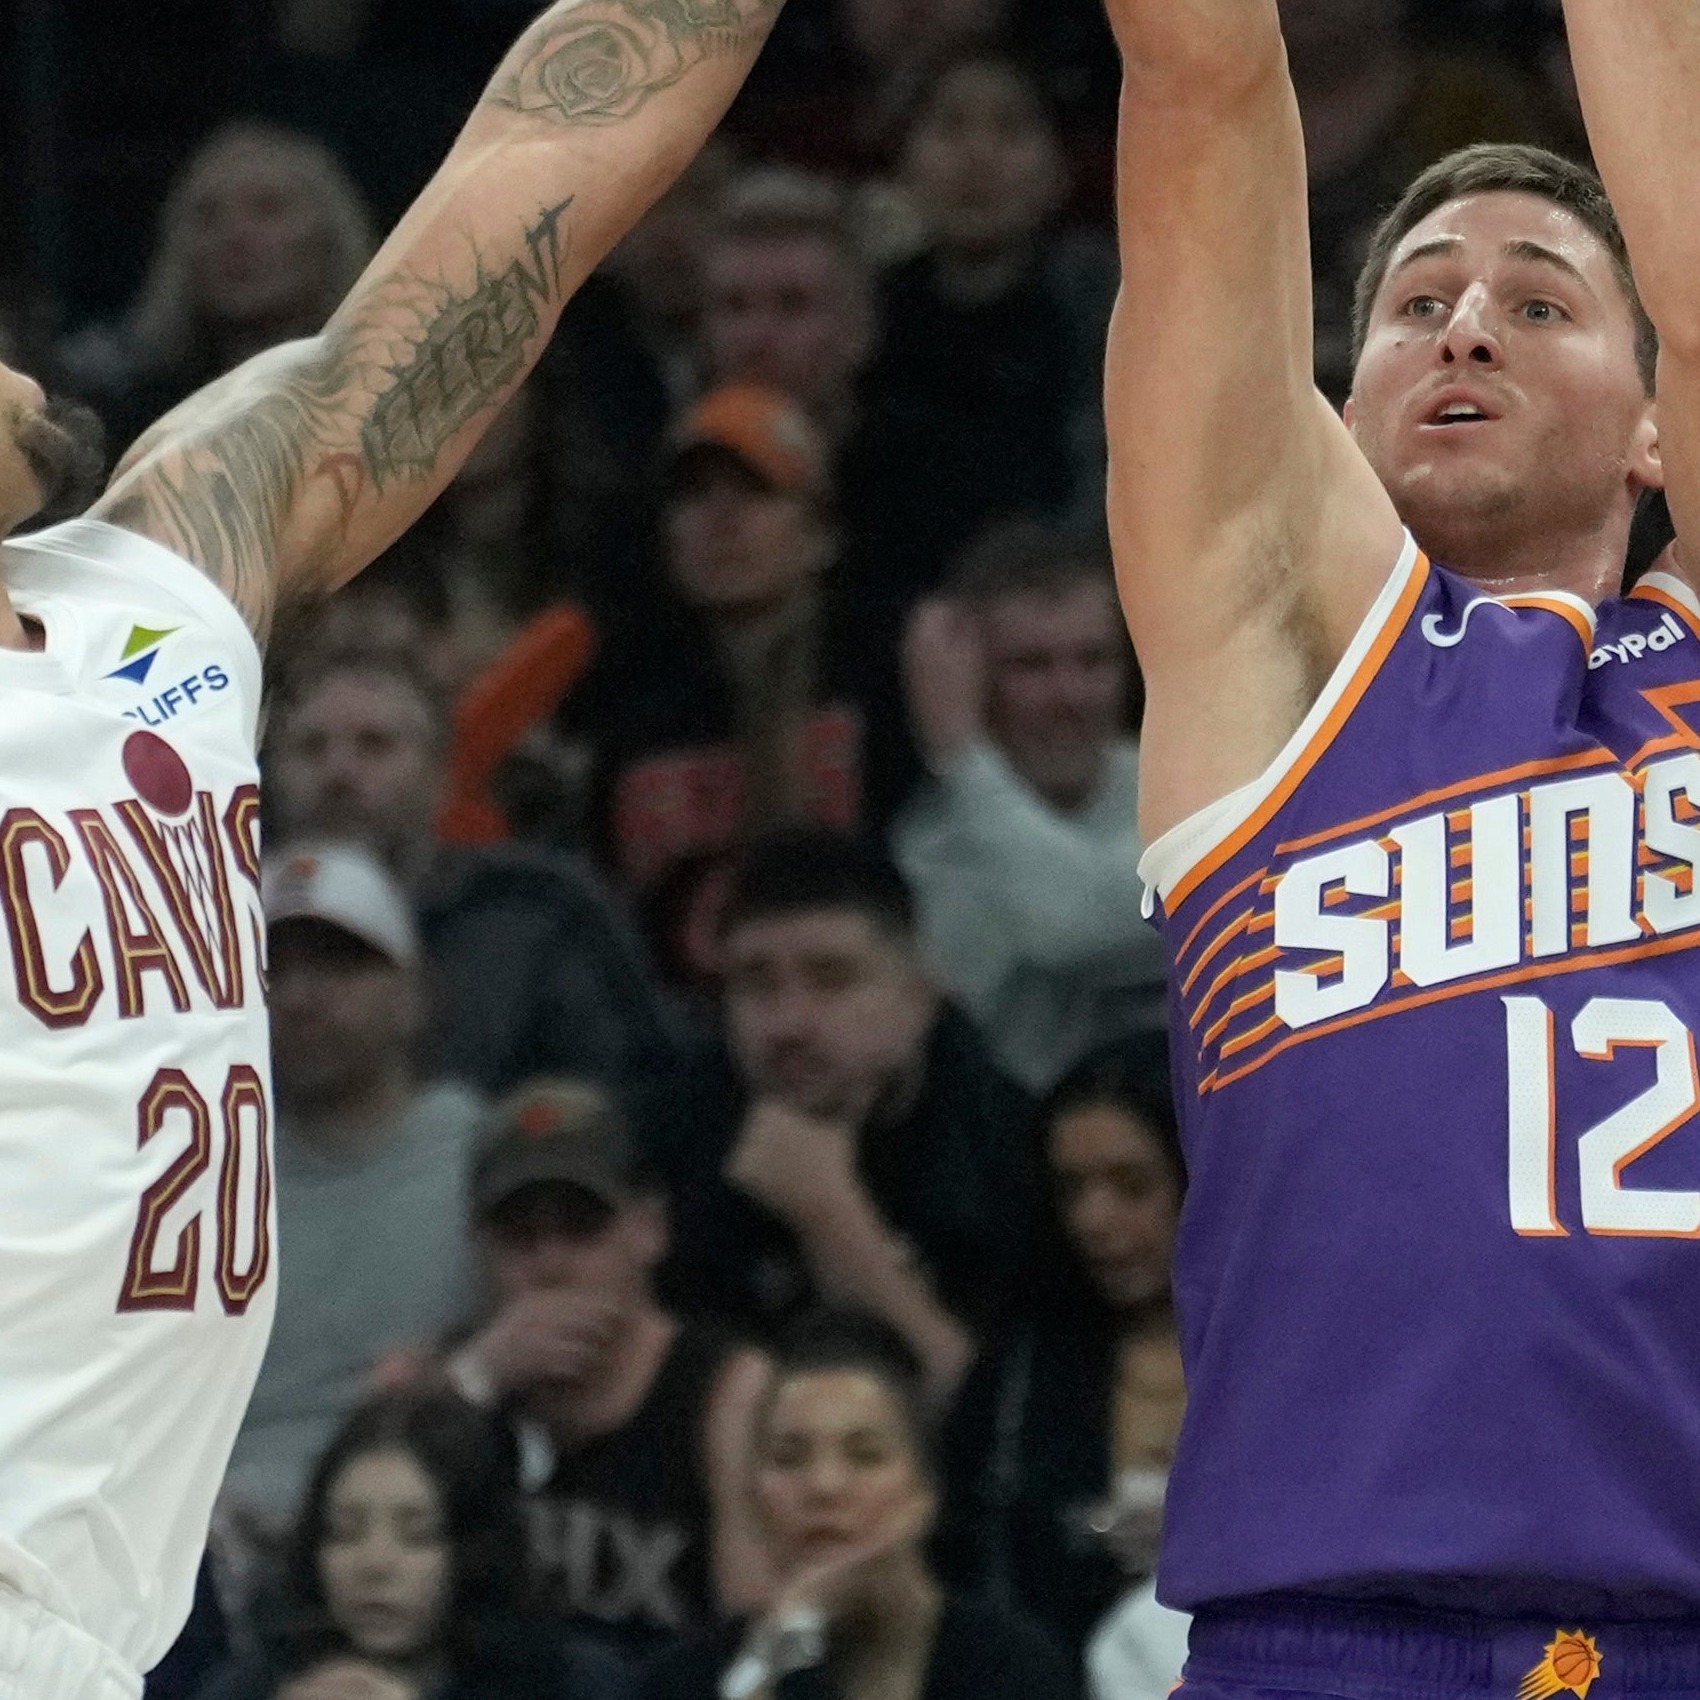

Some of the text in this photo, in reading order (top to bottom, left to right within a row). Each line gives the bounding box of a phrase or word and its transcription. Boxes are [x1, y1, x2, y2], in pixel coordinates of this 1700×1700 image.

[1587, 612, 1686, 670] ayPal
[121, 664, 229, 726] LIFFS
[115, 1063, 269, 1316] 20
